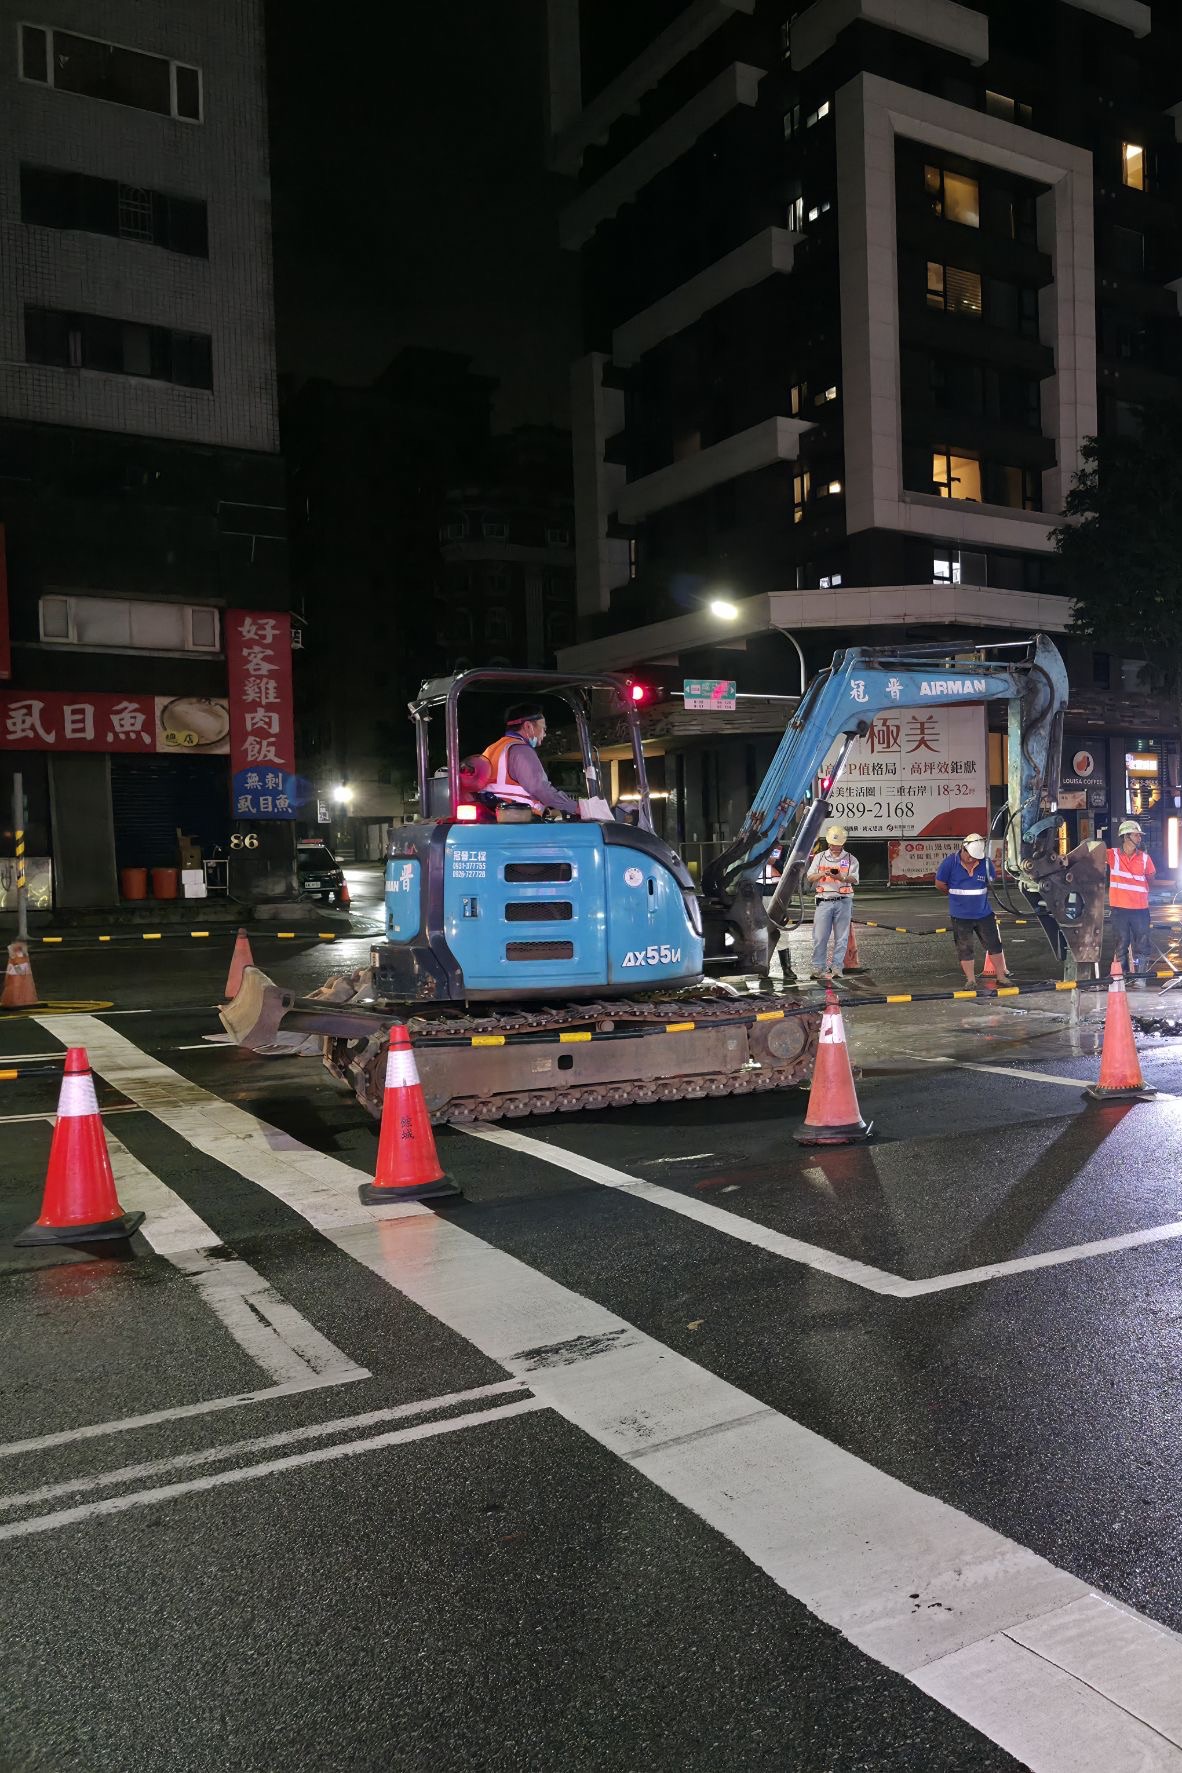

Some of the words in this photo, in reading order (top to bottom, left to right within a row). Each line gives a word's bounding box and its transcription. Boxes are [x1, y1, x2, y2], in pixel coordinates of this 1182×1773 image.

[237, 616, 287, 764] 好客雞肉飯
[919, 679, 986, 696] AIRMAN
[5, 699, 152, 745] 虱目魚
[866, 715, 940, 754] 極美
[243, 771, 284, 790] 無刺
[828, 786, 876, 798] 美生活圈
[237, 794, 293, 814] 虱目魚
[828, 801, 915, 819] 2989-2168
[230, 833, 260, 850] 86
